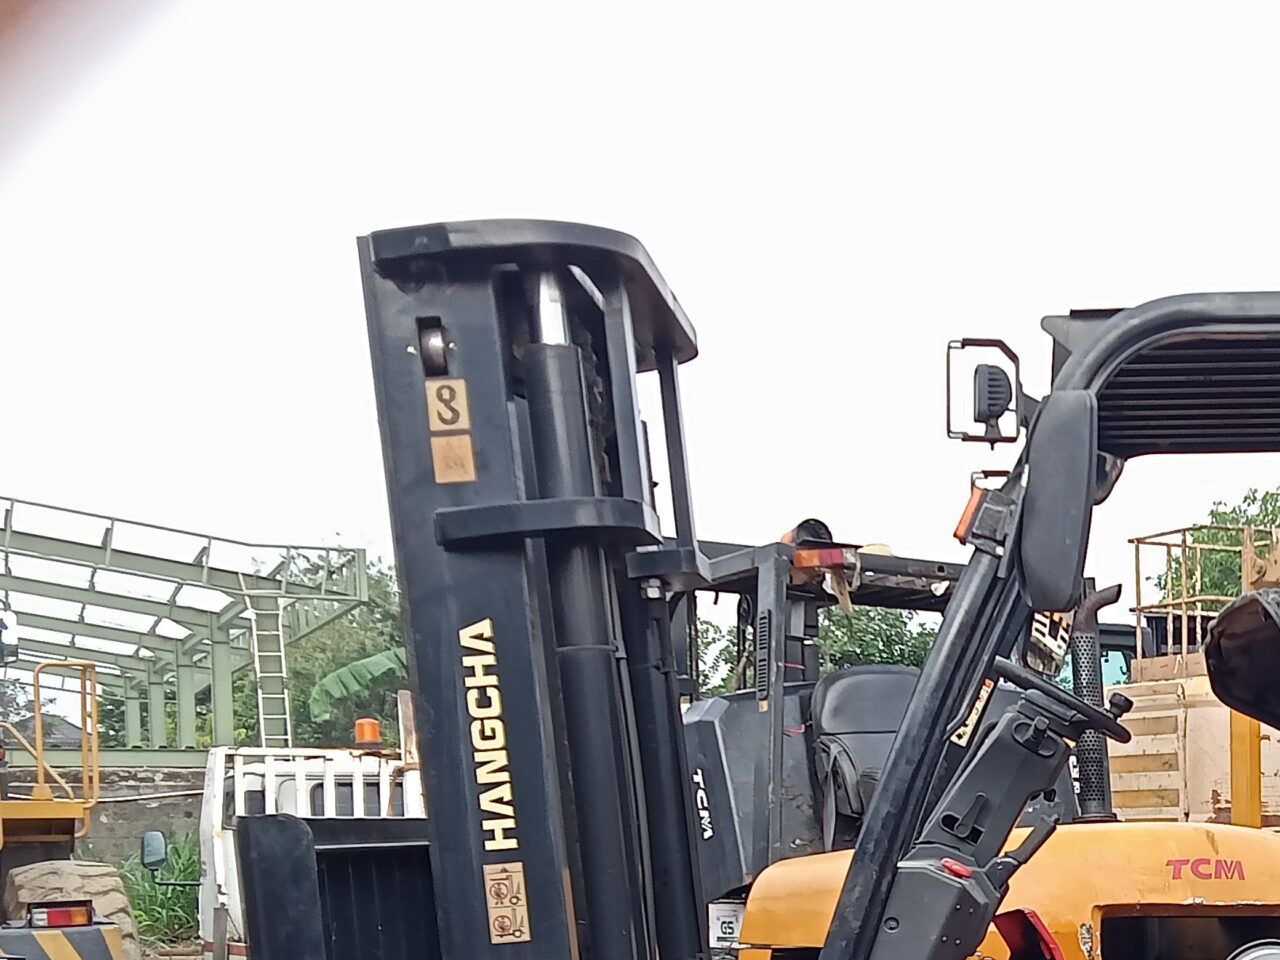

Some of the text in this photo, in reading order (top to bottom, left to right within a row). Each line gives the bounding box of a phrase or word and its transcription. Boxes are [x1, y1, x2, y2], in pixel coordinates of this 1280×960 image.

[458, 617, 519, 851] HANGCHA
[692, 768, 714, 840] TCM
[1165, 858, 1246, 881] TCM
[720, 920, 735, 936] GS
